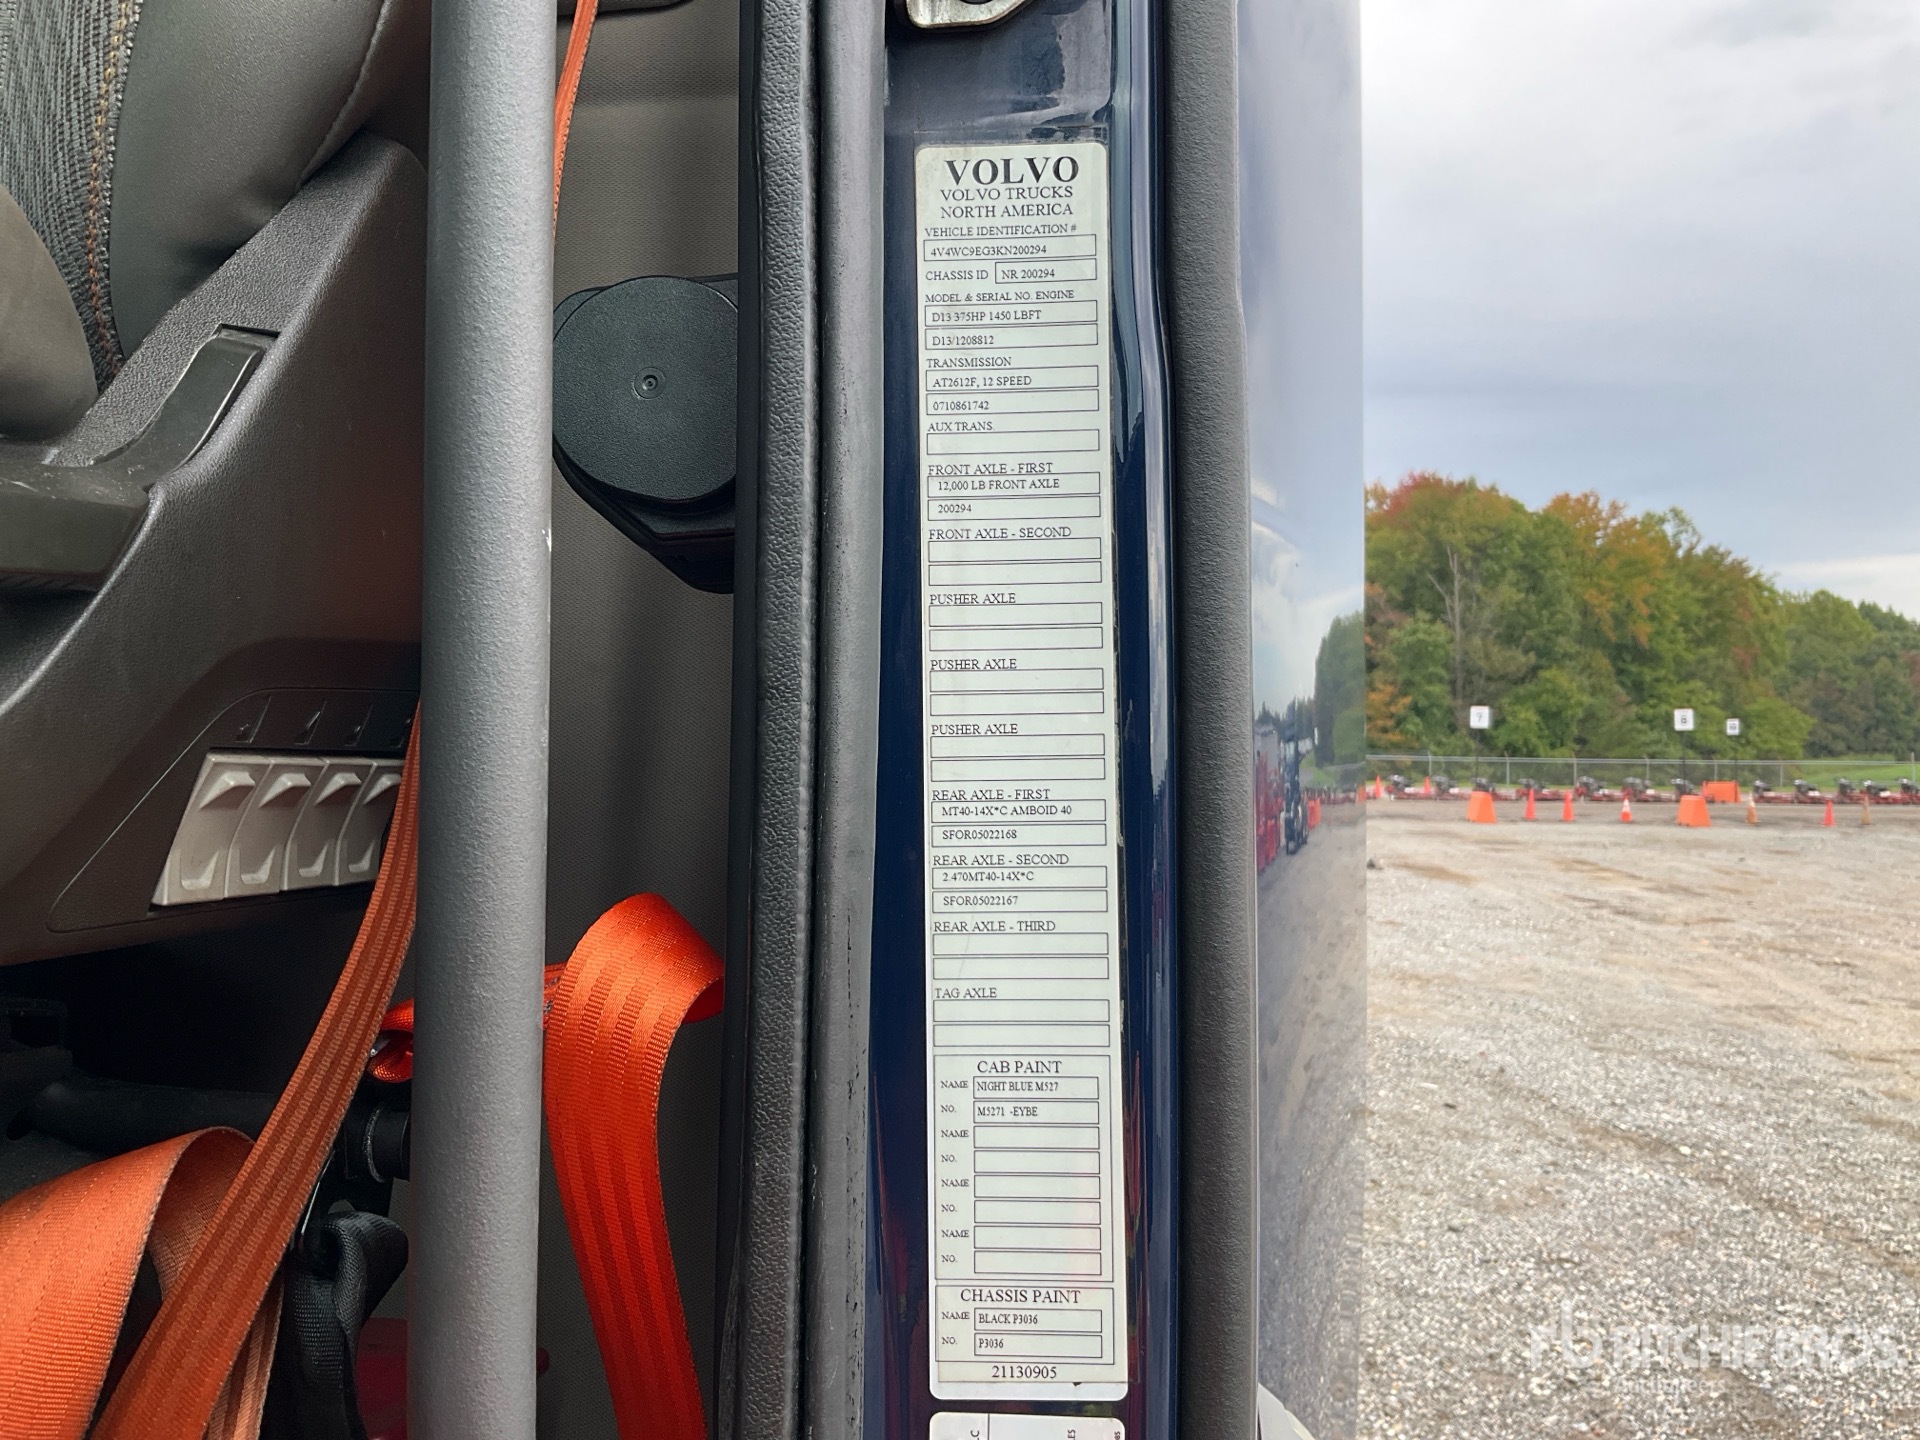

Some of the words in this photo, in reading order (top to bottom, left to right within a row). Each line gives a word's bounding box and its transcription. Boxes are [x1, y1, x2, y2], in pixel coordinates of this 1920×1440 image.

[944, 156, 1079, 185] VOLVO
[941, 188, 1000, 201] VOLVO
[1005, 186, 1073, 199] TRUCKS
[941, 206, 996, 218] NORTH
[1001, 204, 1073, 217] AMERICA
[925, 227, 973, 237] VEHICLE
[977, 224, 1068, 235] IDENTIFICATION
[1070, 224, 1076, 232] #
[931, 245, 1047, 256] 4V4WC9EG3KN200294
[926, 271, 973, 280] CHASSIS
[976, 270, 989, 279] ID
[1002, 270, 1018, 279] NR
[1021, 269, 1055, 278] 200294
[925, 294, 961, 302] MODEL
[976, 292, 1012, 301] SERIAL
[1035, 290, 1074, 299] ENGINE
[932, 312, 952, 322] D13
[954, 312, 986, 321] 375HP
[989, 311, 1011, 320] 1450
[1014, 310, 1042, 320] LBFT
[926, 357, 1012, 368] TRANSMISSION
[933, 378, 979, 388] AT2612F,
[983, 377, 993, 386] 12
[996, 376, 1032, 385] SPEED
[933, 401, 989, 410] 0710861742
[928, 422, 952, 431] AUX
[928, 465, 970, 475] FRONT
[974, 464, 1007, 474] AXLE
[1018, 463, 1053, 473] FIRST
[938, 481, 969, 491] 12,000
[971, 480, 986, 490] LB
[989, 479, 1027, 490] FRONT
[1029, 479, 1060, 489] AXLE
[938, 504, 972, 513] 200294
[929, 529, 971, 539] FRONT
[975, 528, 1008, 539] AXLE
[1019, 527, 1071, 537] SECOND
[930, 594, 979, 604] PUSHER
[983, 593, 1016, 604] AXLE
[931, 659, 980, 670] PUSHER
[984, 659, 1017, 669] AXLE
[931, 724, 980, 735] PUSHER
[984, 724, 1018, 734] AXLE
[932, 790, 967, 800] REAR
[970, 789, 1004, 800] AXLE
[1015, 789, 1050, 799] FIRST
[1010, 806, 1058, 815] AMBOID
[1061, 805, 1072, 815] 40
[942, 829, 1017, 840] SFOR05022168
[933, 855, 968, 866] REAR
[971, 855, 1005, 865] AXLE
[1016, 854, 1069, 865] SECOND
[943, 896, 1018, 906] SFOR05022167
[934, 921, 969, 932] REAR
[972, 921, 1006, 931] AXLE
[1017, 920, 1056, 931] THIRD
[935, 988, 960, 999] TAG
[964, 988, 997, 998] AXLE
[977, 1061, 1010, 1073] CAB
[1014, 1061, 1062, 1074] PAINT
[941, 1081, 969, 1089] NAME
[977, 1082, 1007, 1091] NIGHT
[1008, 1082, 1033, 1091] BLUE
[1035, 1082, 1059, 1091] M527
[977, 1107, 1005, 1116] M5271
[1010, 1107, 1038, 1116] -EYBE
[941, 1130, 969, 1138] NAME
[941, 1179, 969, 1187] NAME
[941, 1230, 969, 1238] NAME
[960, 1289, 1028, 1303] CHASSIS
[1032, 1290, 1080, 1303] PAINT
[942, 1312, 970, 1320] NAME
[979, 1314, 1011, 1324] BLACK
[1013, 1315, 1038, 1324] P3036
[979, 1339, 1004, 1348] P3036
[992, 1366, 1057, 1379] 21130905
